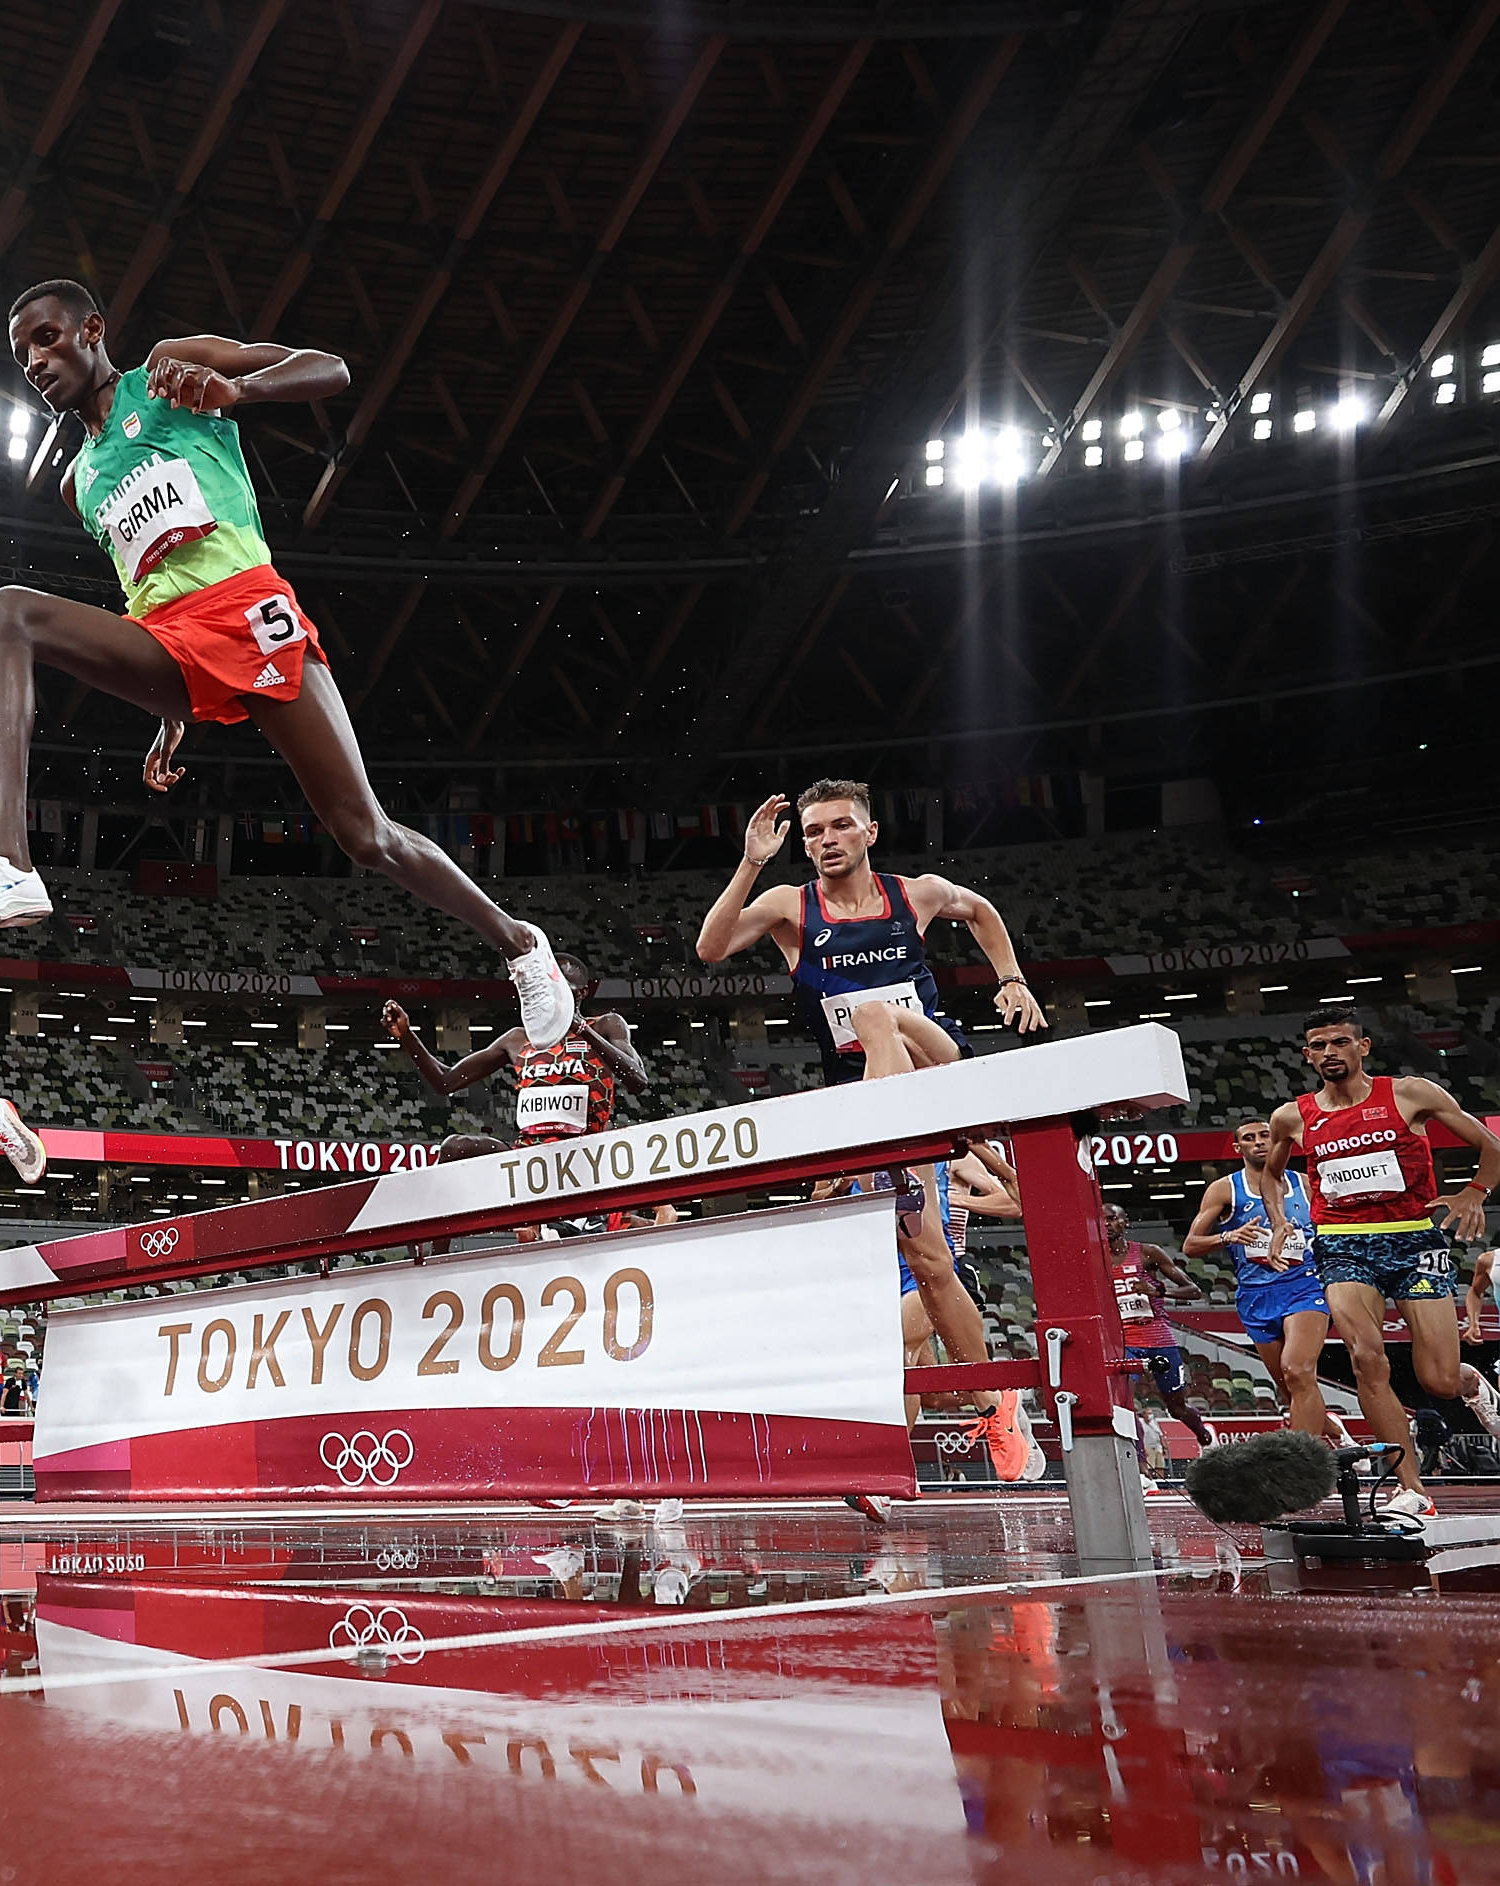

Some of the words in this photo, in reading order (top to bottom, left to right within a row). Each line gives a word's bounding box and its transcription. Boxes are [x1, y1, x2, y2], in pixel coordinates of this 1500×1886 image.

[118, 482, 183, 542] GIRMA
[259, 600, 295, 642] 5
[253, 674, 286, 688] adidas
[832, 946, 907, 968] FRANCE
[1147, 948, 1234, 974] TOKYO
[1242, 941, 1309, 967] 2020
[157, 970, 231, 993] TOKYO
[237, 974, 291, 995] 2020
[627, 978, 701, 999] TOKYO
[710, 976, 766, 995] 2020
[522, 1059, 586, 1080] KENYA
[521, 1096, 583, 1113] KIBIWOT
[1091, 1133, 1179, 1166] 2020
[1314, 1129, 1397, 1157] MOROCCO
[273, 1139, 381, 1173] TOKYO
[389, 1144, 441, 1172] 202
[500, 1140, 633, 1198] TOKYO
[647, 1117, 759, 1175] 2020
[1246, 1240, 1305, 1250] ABDEAHED
[1423, 1254, 1449, 1275] 10
[1119, 1300, 1143, 1312] ETER
[158, 1298, 393, 1397] TOKYO
[416, 1267, 654, 1377] 2020
[1219, 1432, 1261, 1445] OKY
